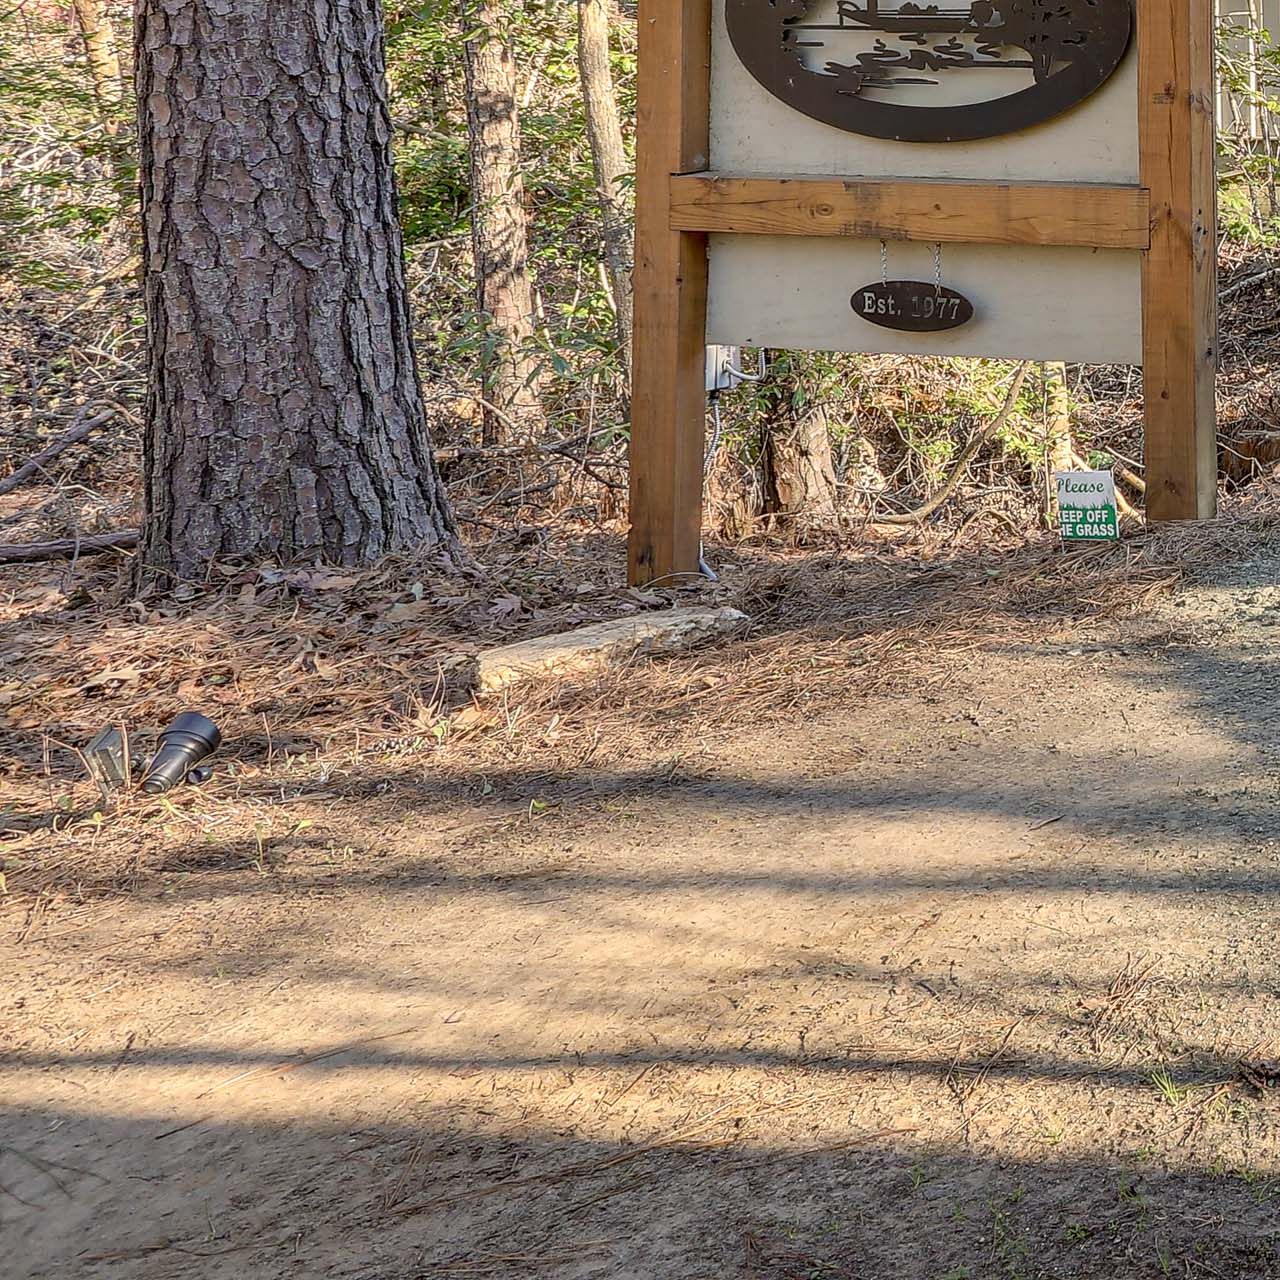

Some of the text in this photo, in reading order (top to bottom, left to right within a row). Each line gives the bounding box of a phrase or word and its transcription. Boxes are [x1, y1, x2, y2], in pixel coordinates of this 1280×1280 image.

[863, 292, 960, 320] Est. 1977
[1056, 477, 1104, 494] Please
[1086, 510, 1108, 523] OFF
[1060, 524, 1115, 537] HE GRASS
